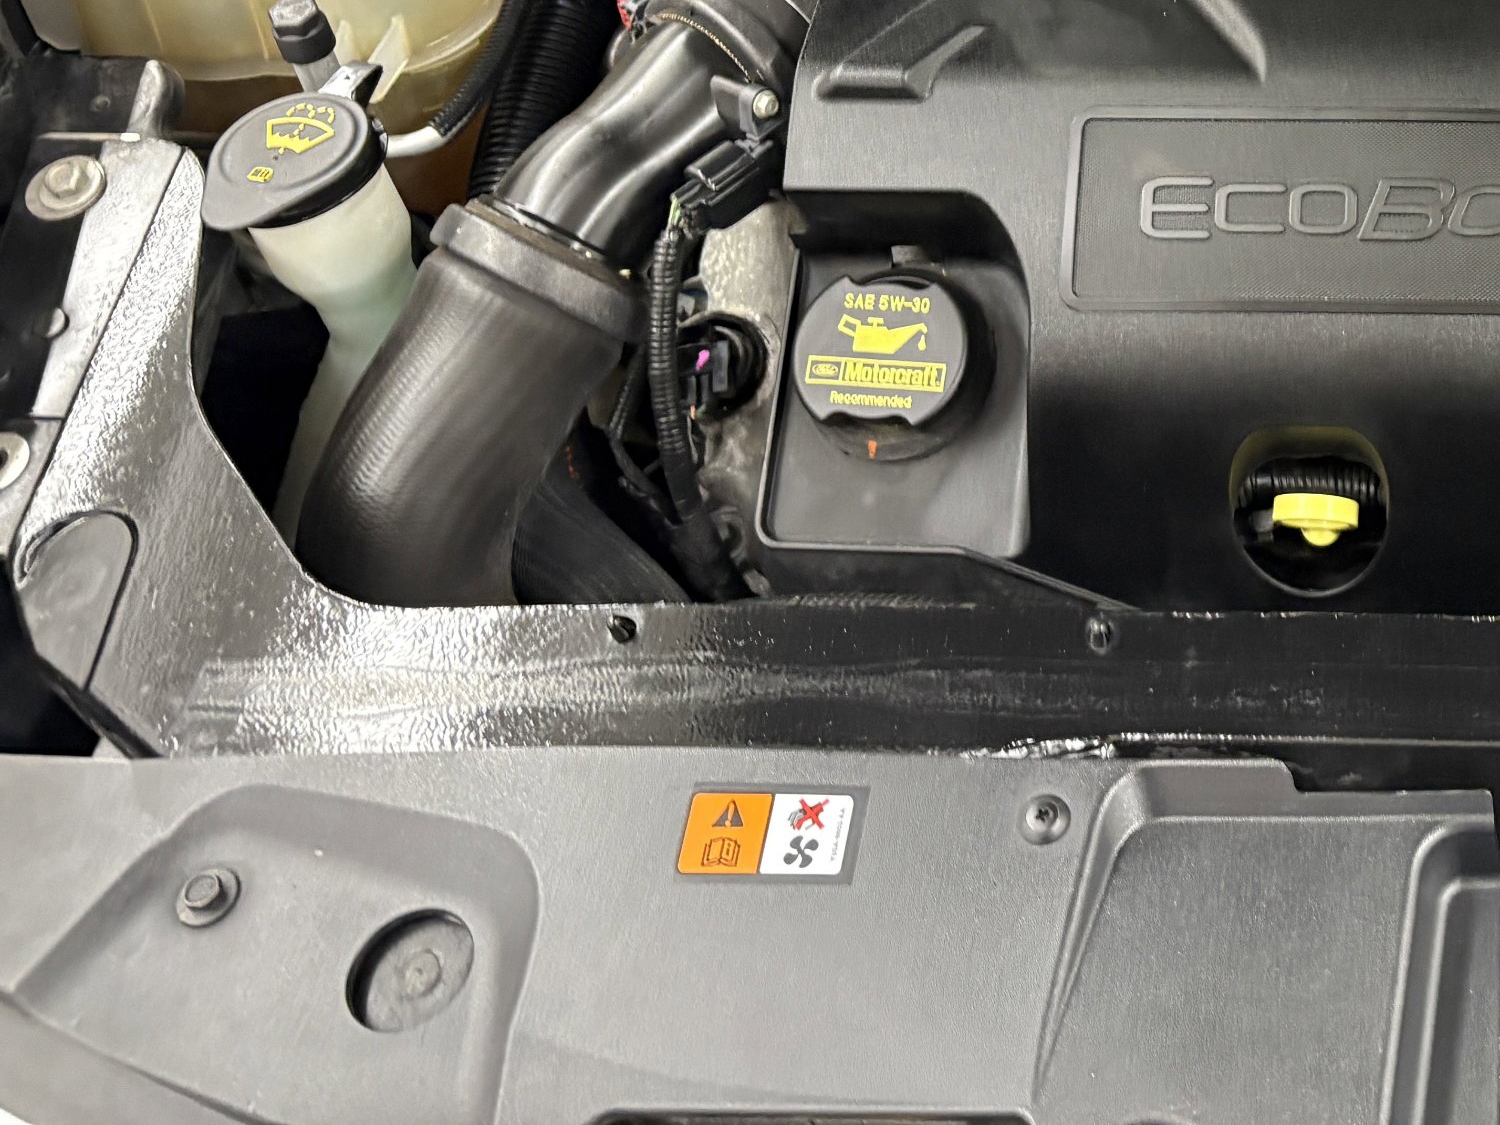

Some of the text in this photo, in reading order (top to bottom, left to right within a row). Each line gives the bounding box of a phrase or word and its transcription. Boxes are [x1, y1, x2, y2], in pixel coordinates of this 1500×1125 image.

[844, 292, 931, 314] SAE 5W-30
[844, 360, 938, 387] Motorcraft
[829, 390, 913, 409] Recommended
